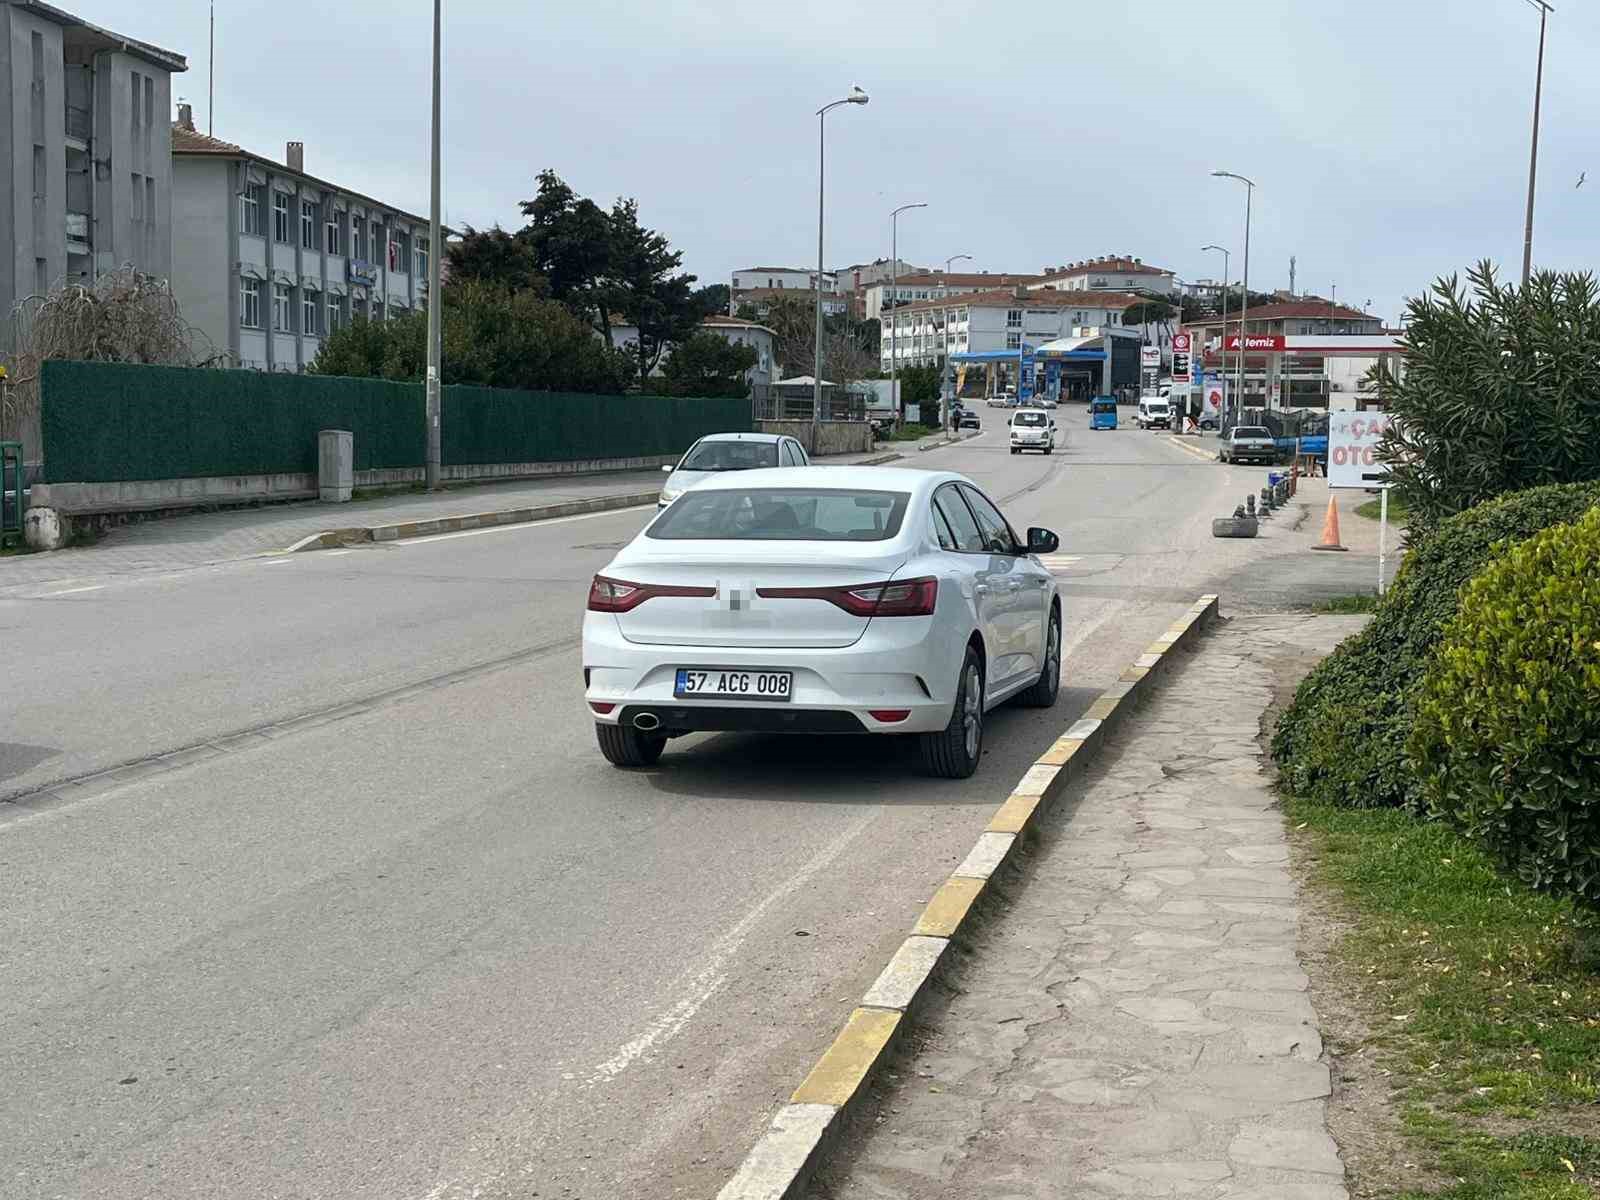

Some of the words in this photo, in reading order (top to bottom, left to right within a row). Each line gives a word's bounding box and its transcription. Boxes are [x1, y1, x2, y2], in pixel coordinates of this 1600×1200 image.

[686, 672, 707, 691] 57
[717, 673, 750, 692] ACG
[757, 675, 788, 693] 008
